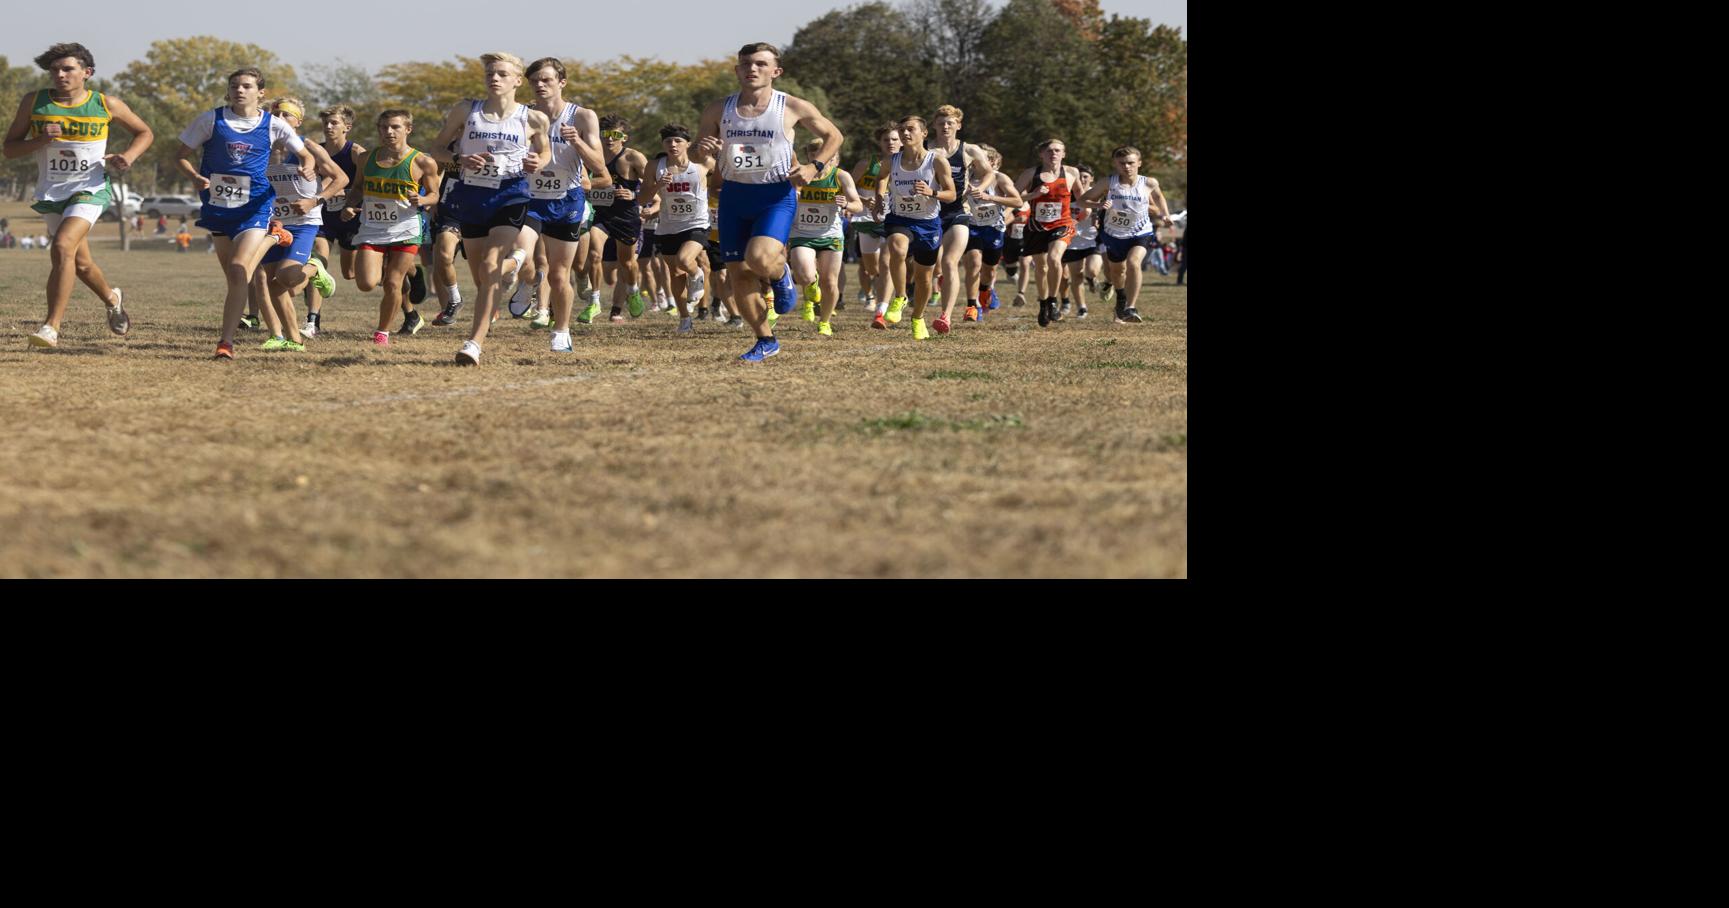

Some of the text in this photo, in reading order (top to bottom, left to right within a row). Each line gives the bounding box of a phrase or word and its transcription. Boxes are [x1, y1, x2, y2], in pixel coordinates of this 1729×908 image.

[468, 131, 519, 144] CHRISTIAN
[726, 127, 774, 139] CHRISTIAN
[49, 158, 89, 172] 1018
[734, 155, 764, 168] 951
[535, 178, 561, 190] 948
[666, 182, 690, 192] JCC
[214, 184, 244, 198] 994
[588, 190, 613, 200] 1008
[1110, 194, 1142, 202] CHRISTIAN
[671, 204, 693, 213] 938
[900, 202, 921, 212] 952
[368, 210, 398, 221] 1016
[800, 214, 828, 223] 1020
[977, 209, 995, 220] 949
[1111, 216, 1130, 227] 950
